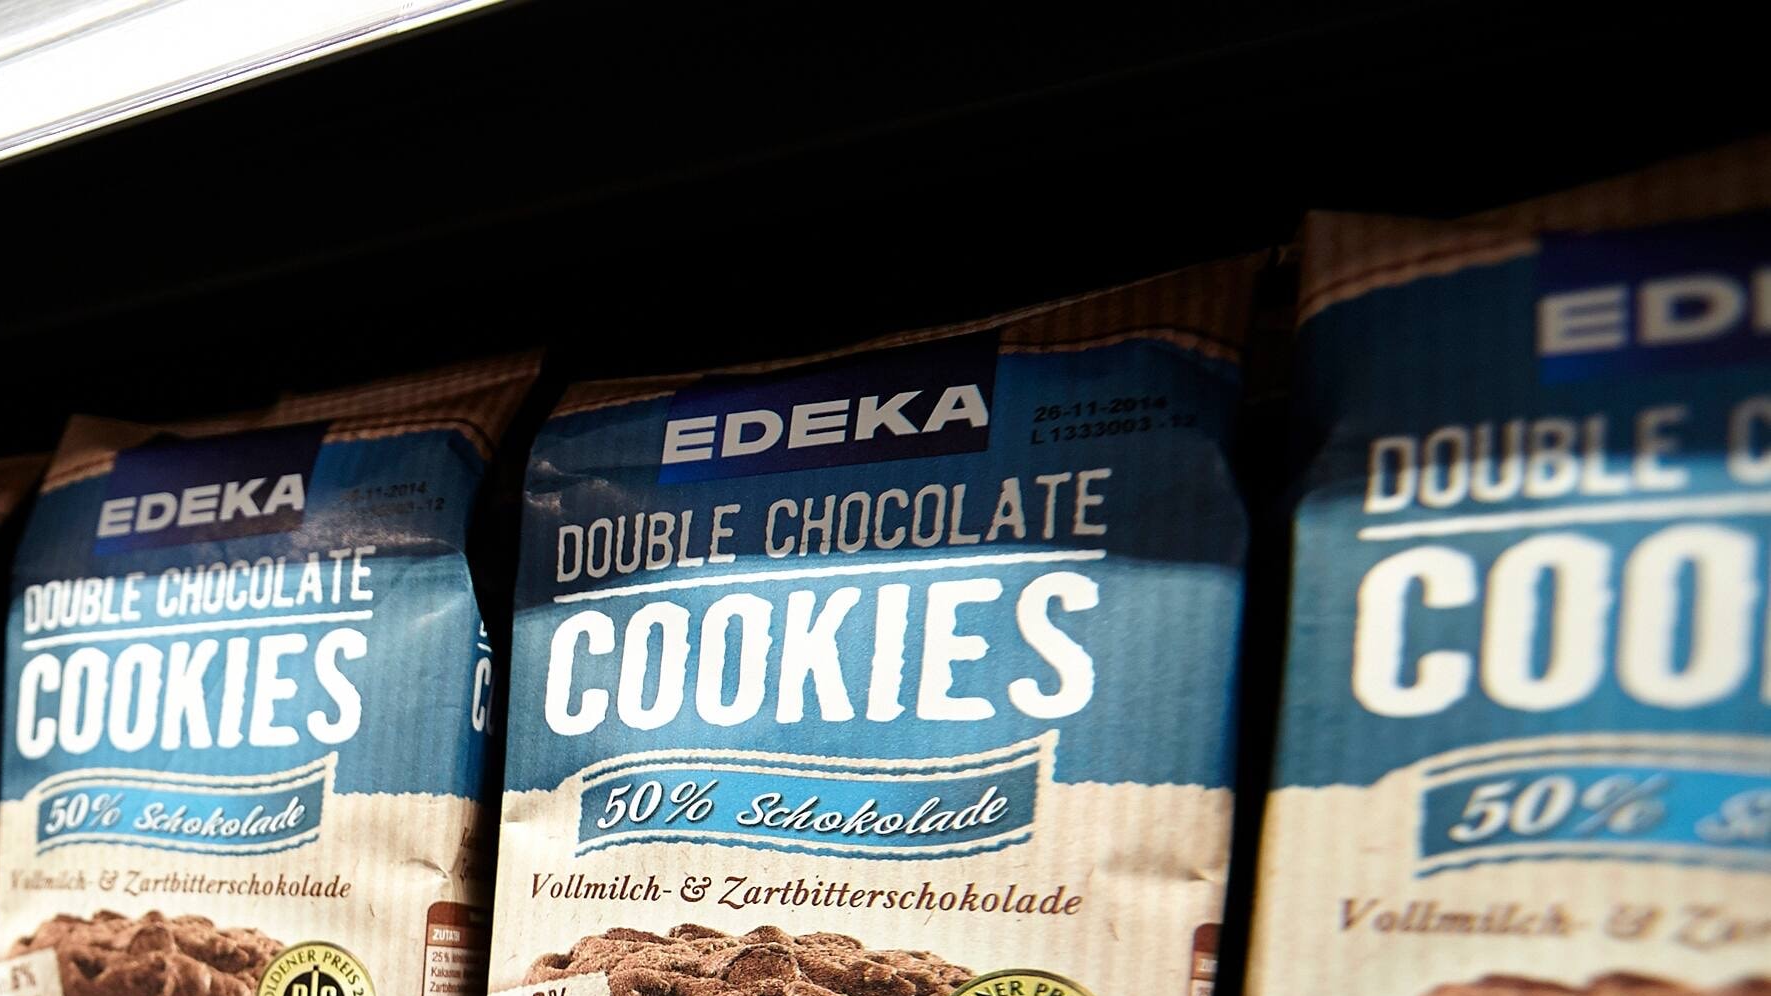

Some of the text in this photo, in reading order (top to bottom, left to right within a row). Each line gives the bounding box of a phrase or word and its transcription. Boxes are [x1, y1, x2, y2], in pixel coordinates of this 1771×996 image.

[1534, 266, 1771, 356] ED
[661, 383, 990, 467] EDEKA
[1364, 404, 1690, 514] DOUBLE
[95, 472, 306, 539] EDEKA
[556, 467, 1114, 585] DOUBLE CHOCOLATE
[24, 544, 377, 635] DOUBLE CHOCOLATE
[1352, 523, 1771, 718] COO
[15, 626, 370, 761] COOKIES
[544, 570, 1102, 738] COOKIES
[45, 793, 306, 839] 50% Schokolade
[596, 779, 1011, 839] 50% Schokolade
[1448, 773, 1671, 843] 50%
[123, 868, 353, 901] Zartbitterschokolade
[530, 872, 1086, 920] Vollmilch- & Zartbitterschokolade
[322, 951, 360, 985] PREIS
